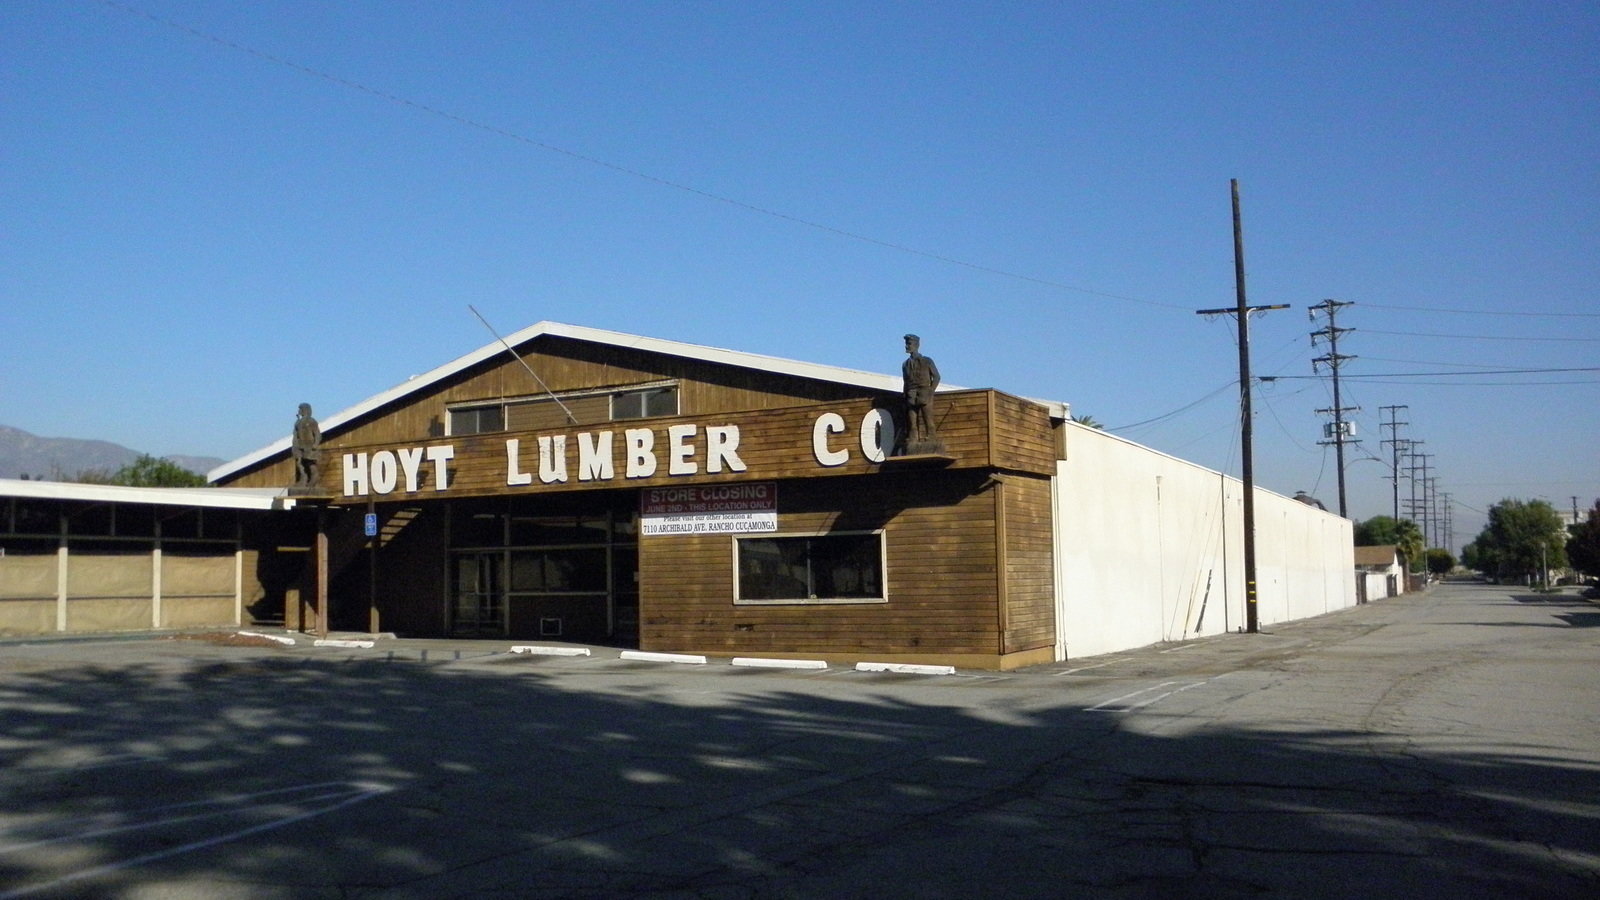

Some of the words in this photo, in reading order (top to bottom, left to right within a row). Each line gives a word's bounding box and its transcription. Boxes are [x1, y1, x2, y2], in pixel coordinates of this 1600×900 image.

[342, 445, 455, 497] HOYT
[506, 424, 747, 486] LUMBER
[650, 488, 697, 503] STORE
[701, 485, 767, 500] CLOSING
[646, 504, 666, 513] JUNE
[689, 503, 706, 511] THIS
[708, 501, 748, 510] LOCATION
[750, 500, 772, 509] ONLY
[643, 525, 658, 534] 7110
[658, 524, 693, 533] ARCHIBALD
[694, 523, 708, 532] AVE.
[708, 522, 735, 531] RANCHO
[735, 521, 776, 530] CUCAMONGA
